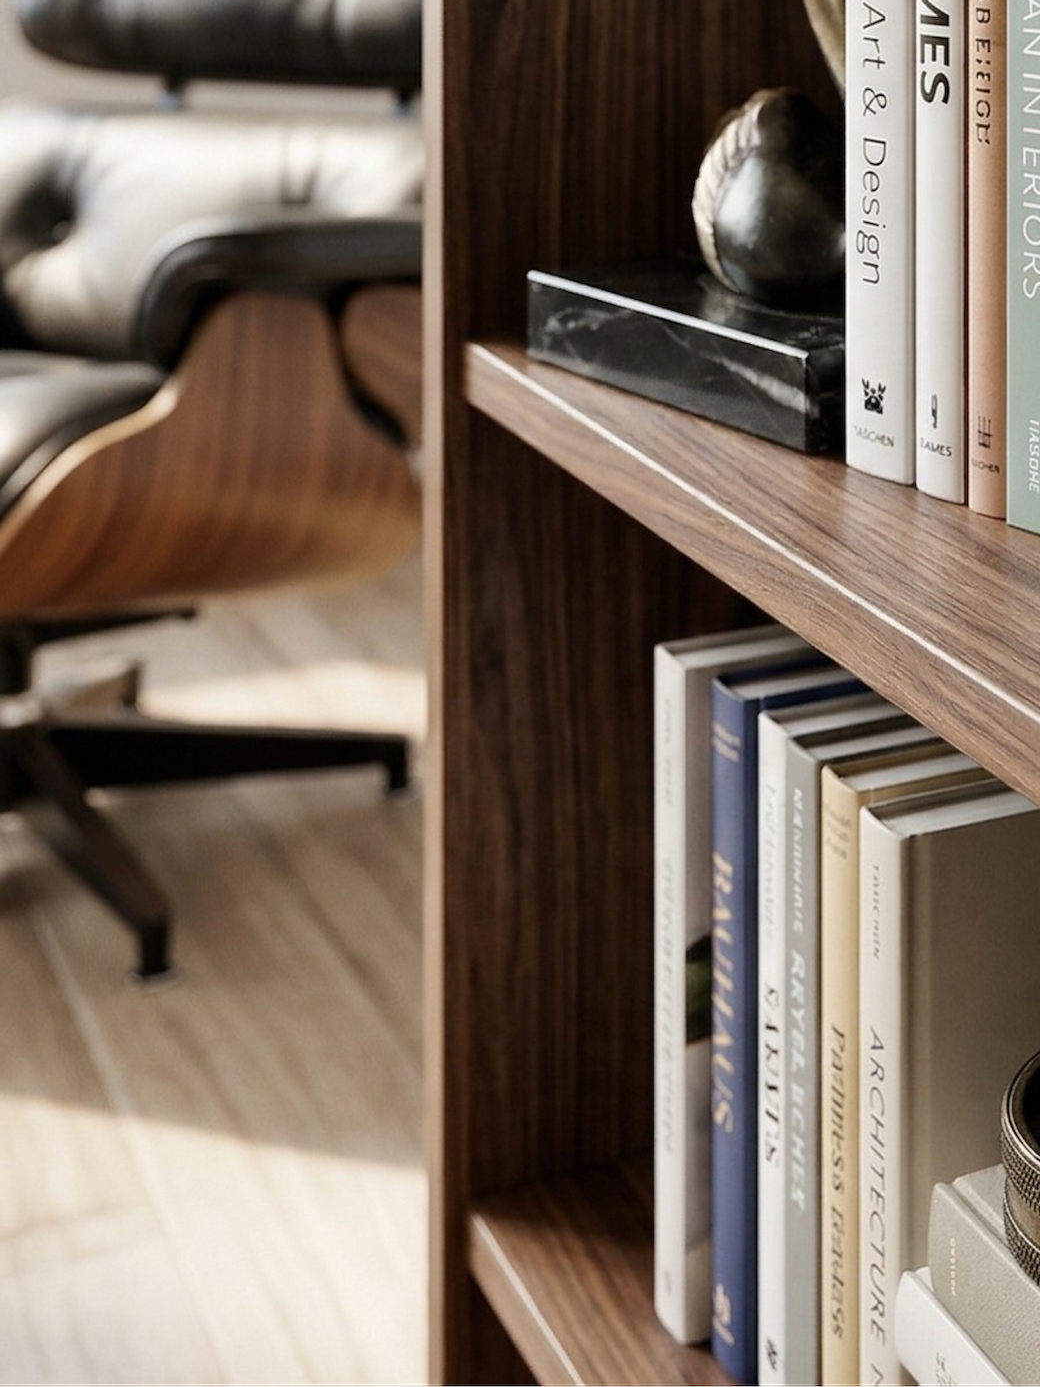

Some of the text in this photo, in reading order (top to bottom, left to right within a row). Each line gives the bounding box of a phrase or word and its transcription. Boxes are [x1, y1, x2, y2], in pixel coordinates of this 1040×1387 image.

[863, 2, 886, 69] Art
[863, 87, 887, 117] &
[856, 138, 886, 285] Design
[713, 852, 734, 1133] BAUHAUS
[869, 1025, 885, 1345] ARCHITECTURE
